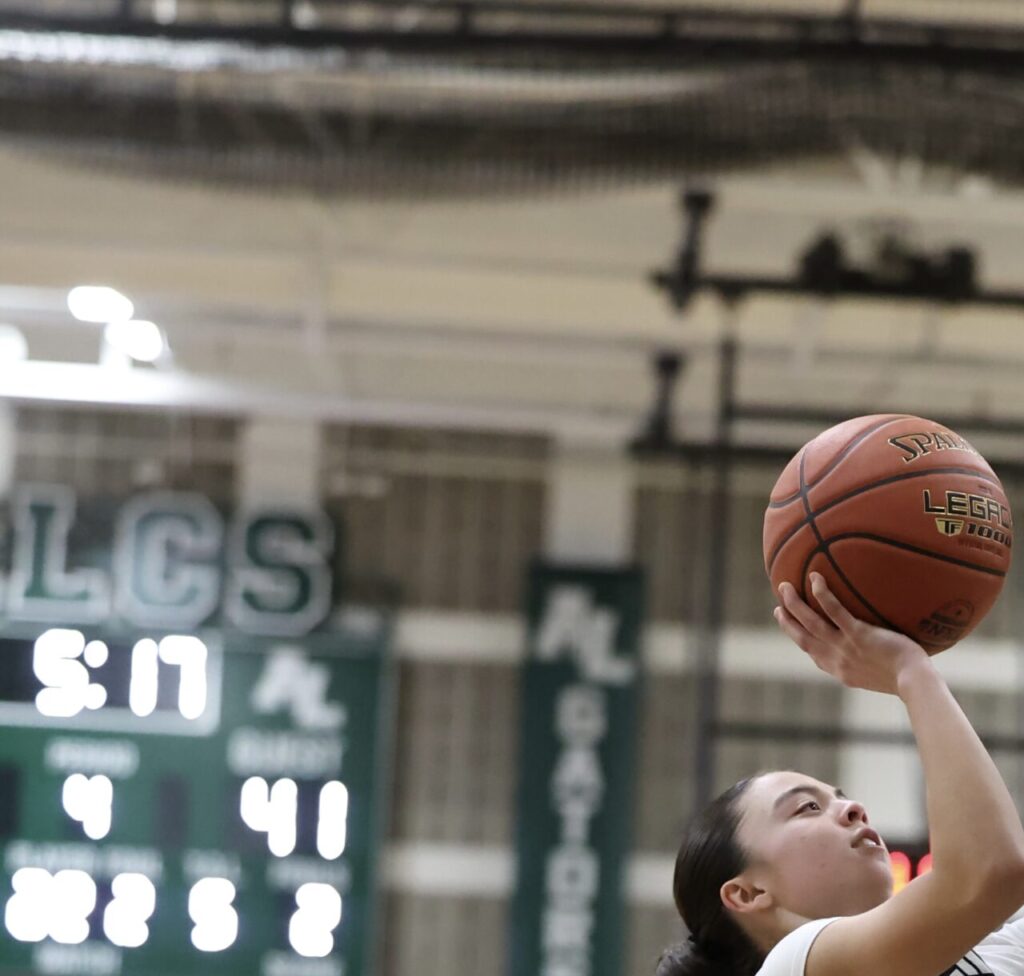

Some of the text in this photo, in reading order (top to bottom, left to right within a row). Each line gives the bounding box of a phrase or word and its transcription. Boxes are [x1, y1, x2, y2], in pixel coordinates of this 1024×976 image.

[888, 432, 977, 464] SPAL
[0, 482, 335, 638] LCS
[33, 628, 208, 720] 5:17
[62, 773, 113, 840] 4
[240, 776, 348, 860] 41
